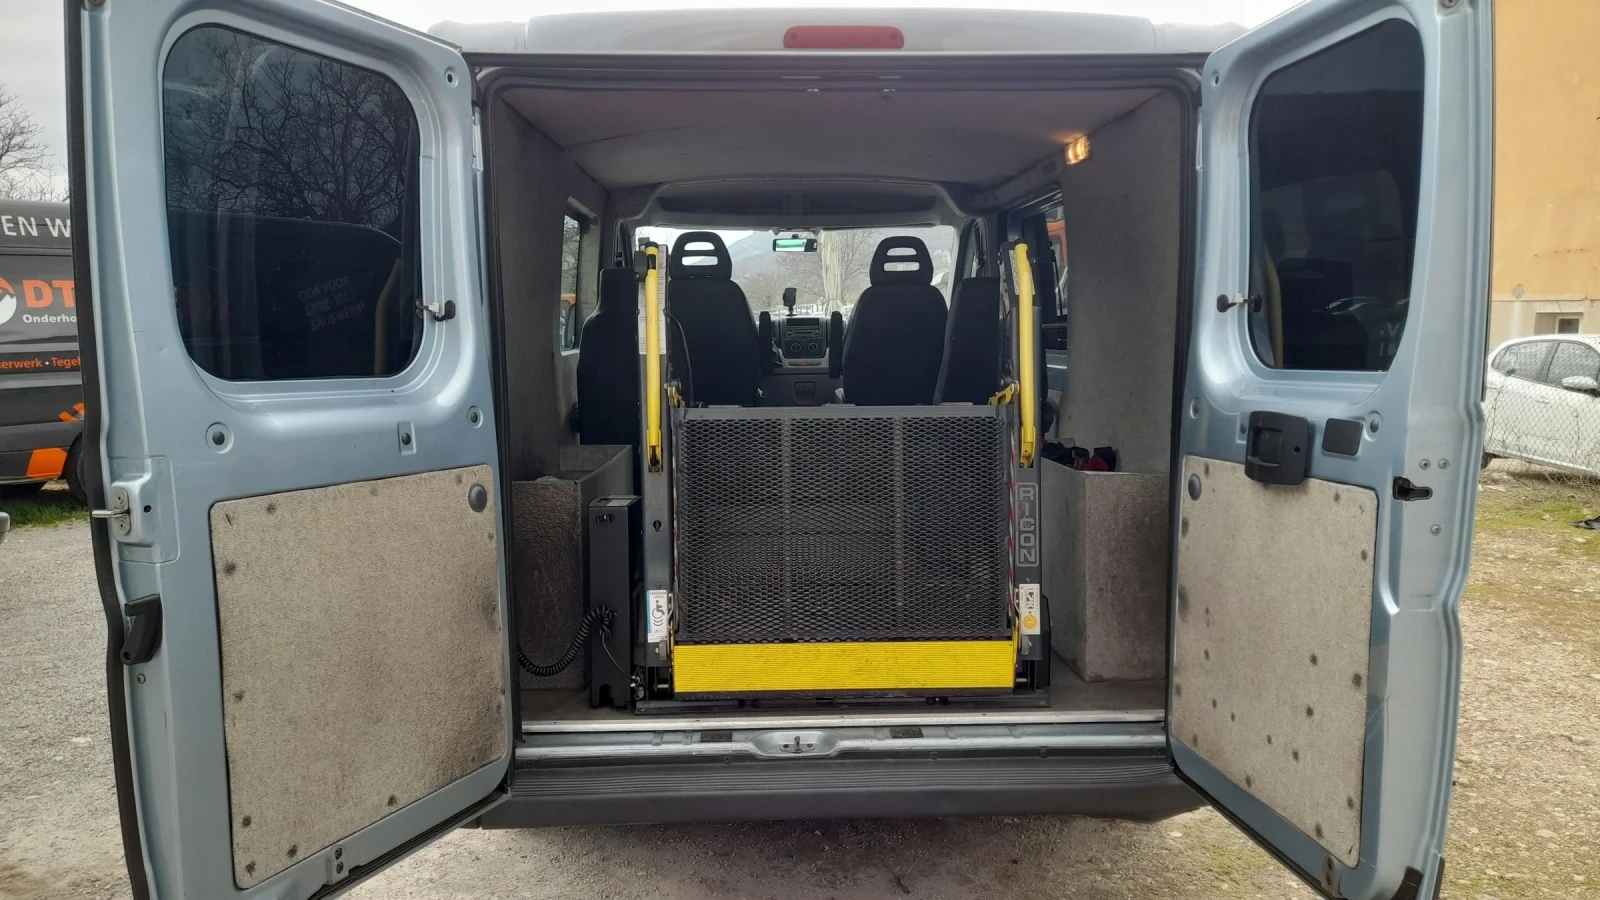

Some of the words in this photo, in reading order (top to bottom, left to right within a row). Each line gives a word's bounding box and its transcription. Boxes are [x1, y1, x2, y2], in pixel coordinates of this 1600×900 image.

[1, 215, 38, 237] EN
[0, 357, 43, 369] erwerk
[1018, 487, 1036, 562] RICON
